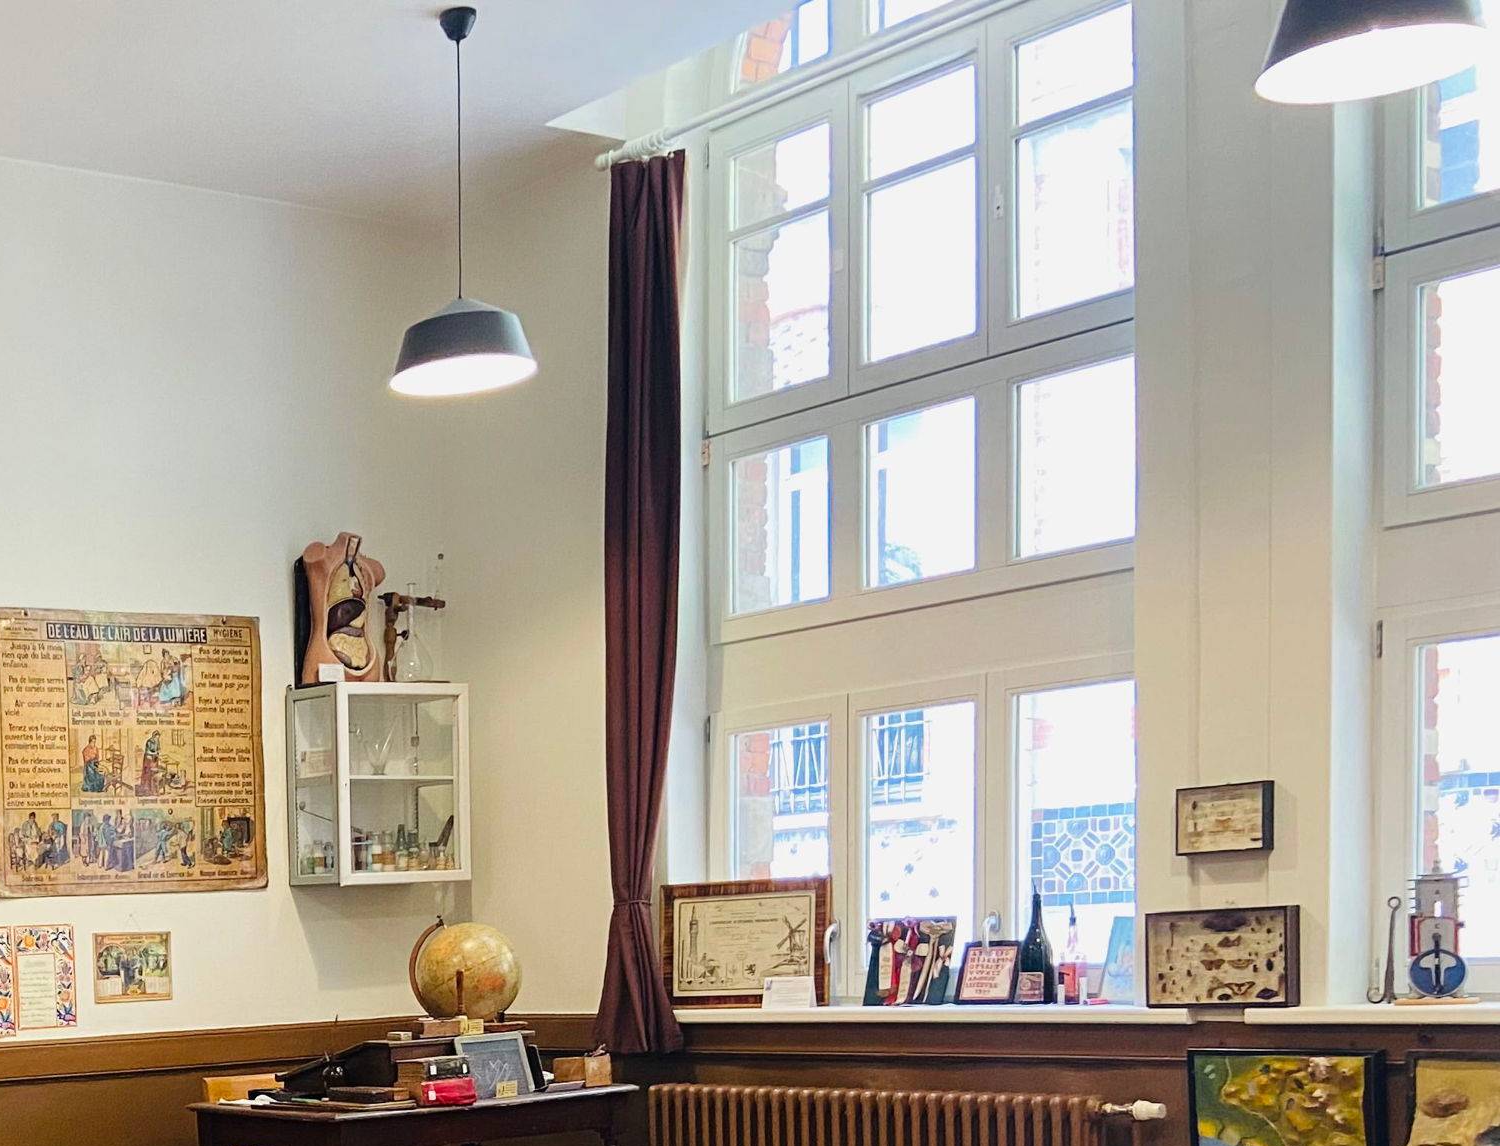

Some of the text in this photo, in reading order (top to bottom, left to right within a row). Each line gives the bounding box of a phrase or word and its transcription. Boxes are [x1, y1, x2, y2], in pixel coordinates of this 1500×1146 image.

[48, 623, 61, 638] DE
[92, 625, 106, 640] DE
[133, 627, 146, 642] DE
[149, 627, 161, 642] LA
